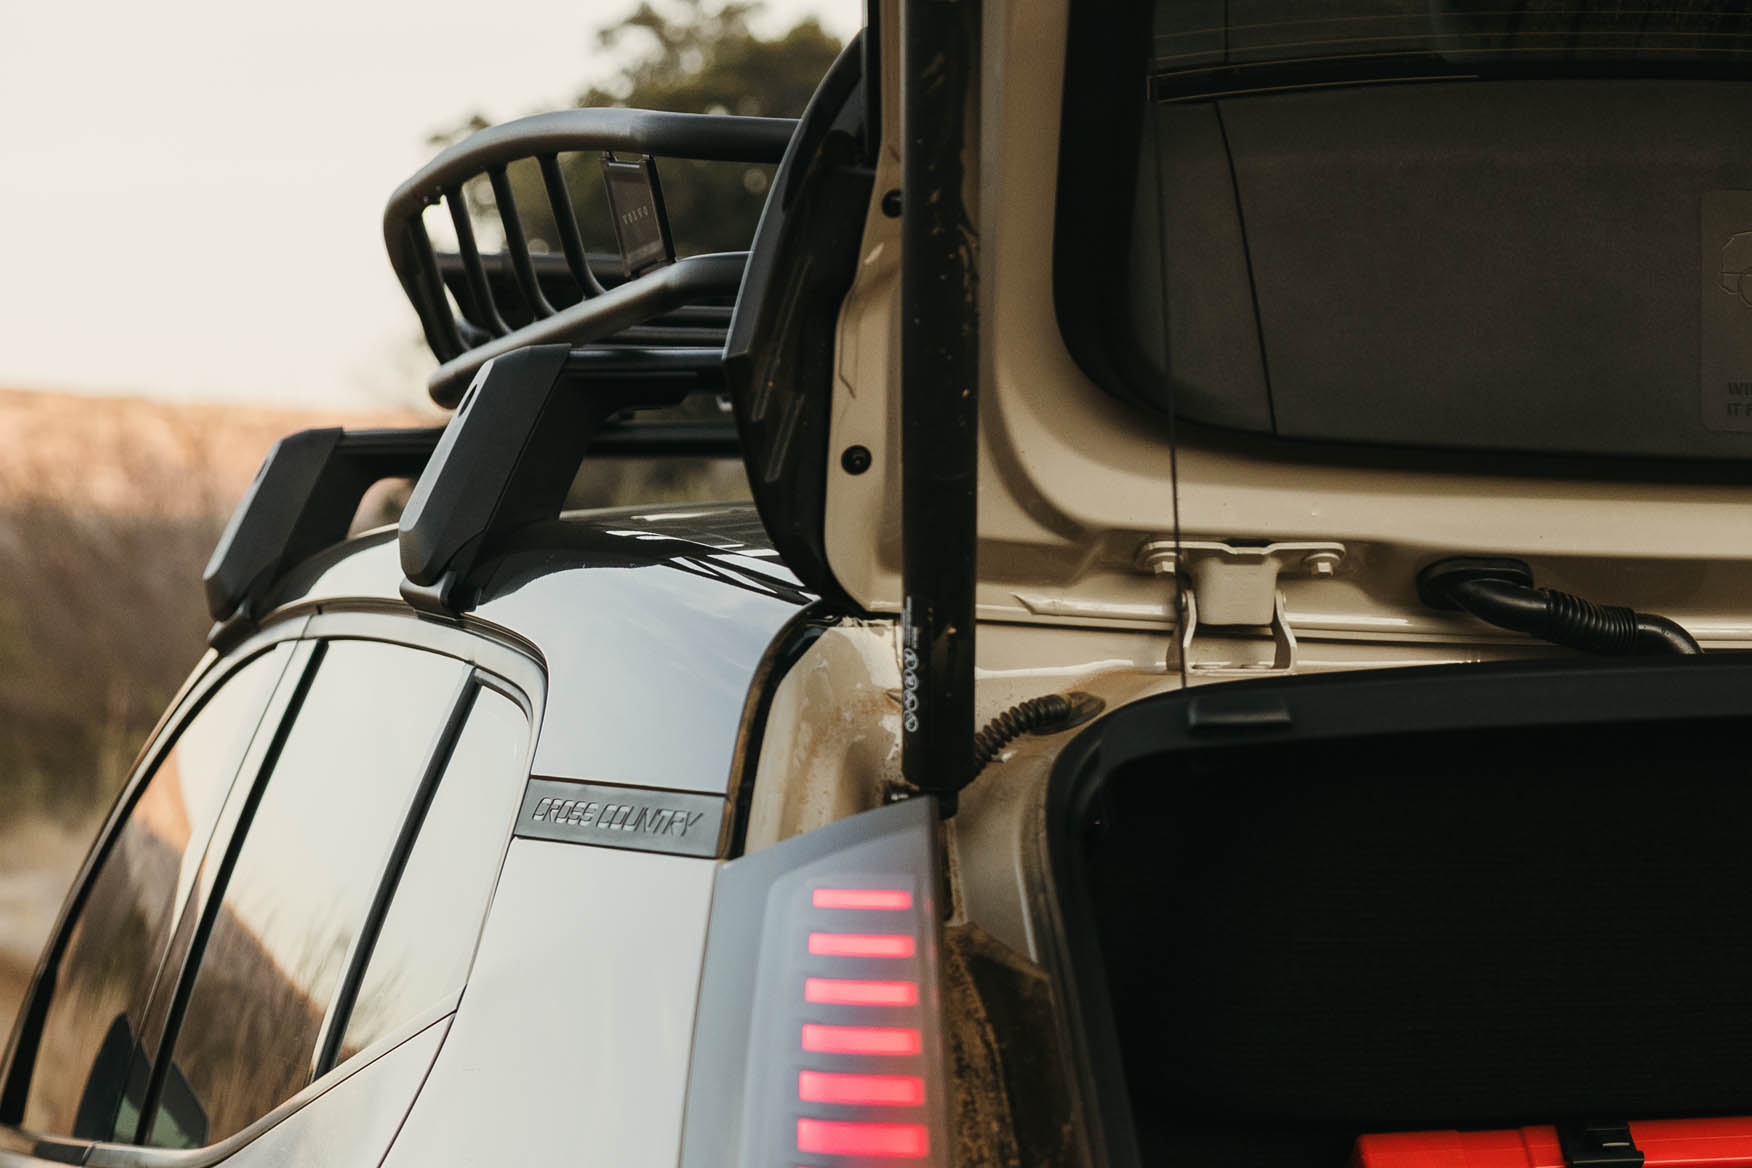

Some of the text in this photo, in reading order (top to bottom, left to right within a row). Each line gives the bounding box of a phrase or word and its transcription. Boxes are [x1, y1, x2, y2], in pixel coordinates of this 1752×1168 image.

[1727, 403, 1743, 417] IT
[531, 796, 704, 837] CROSS COUNTRY
